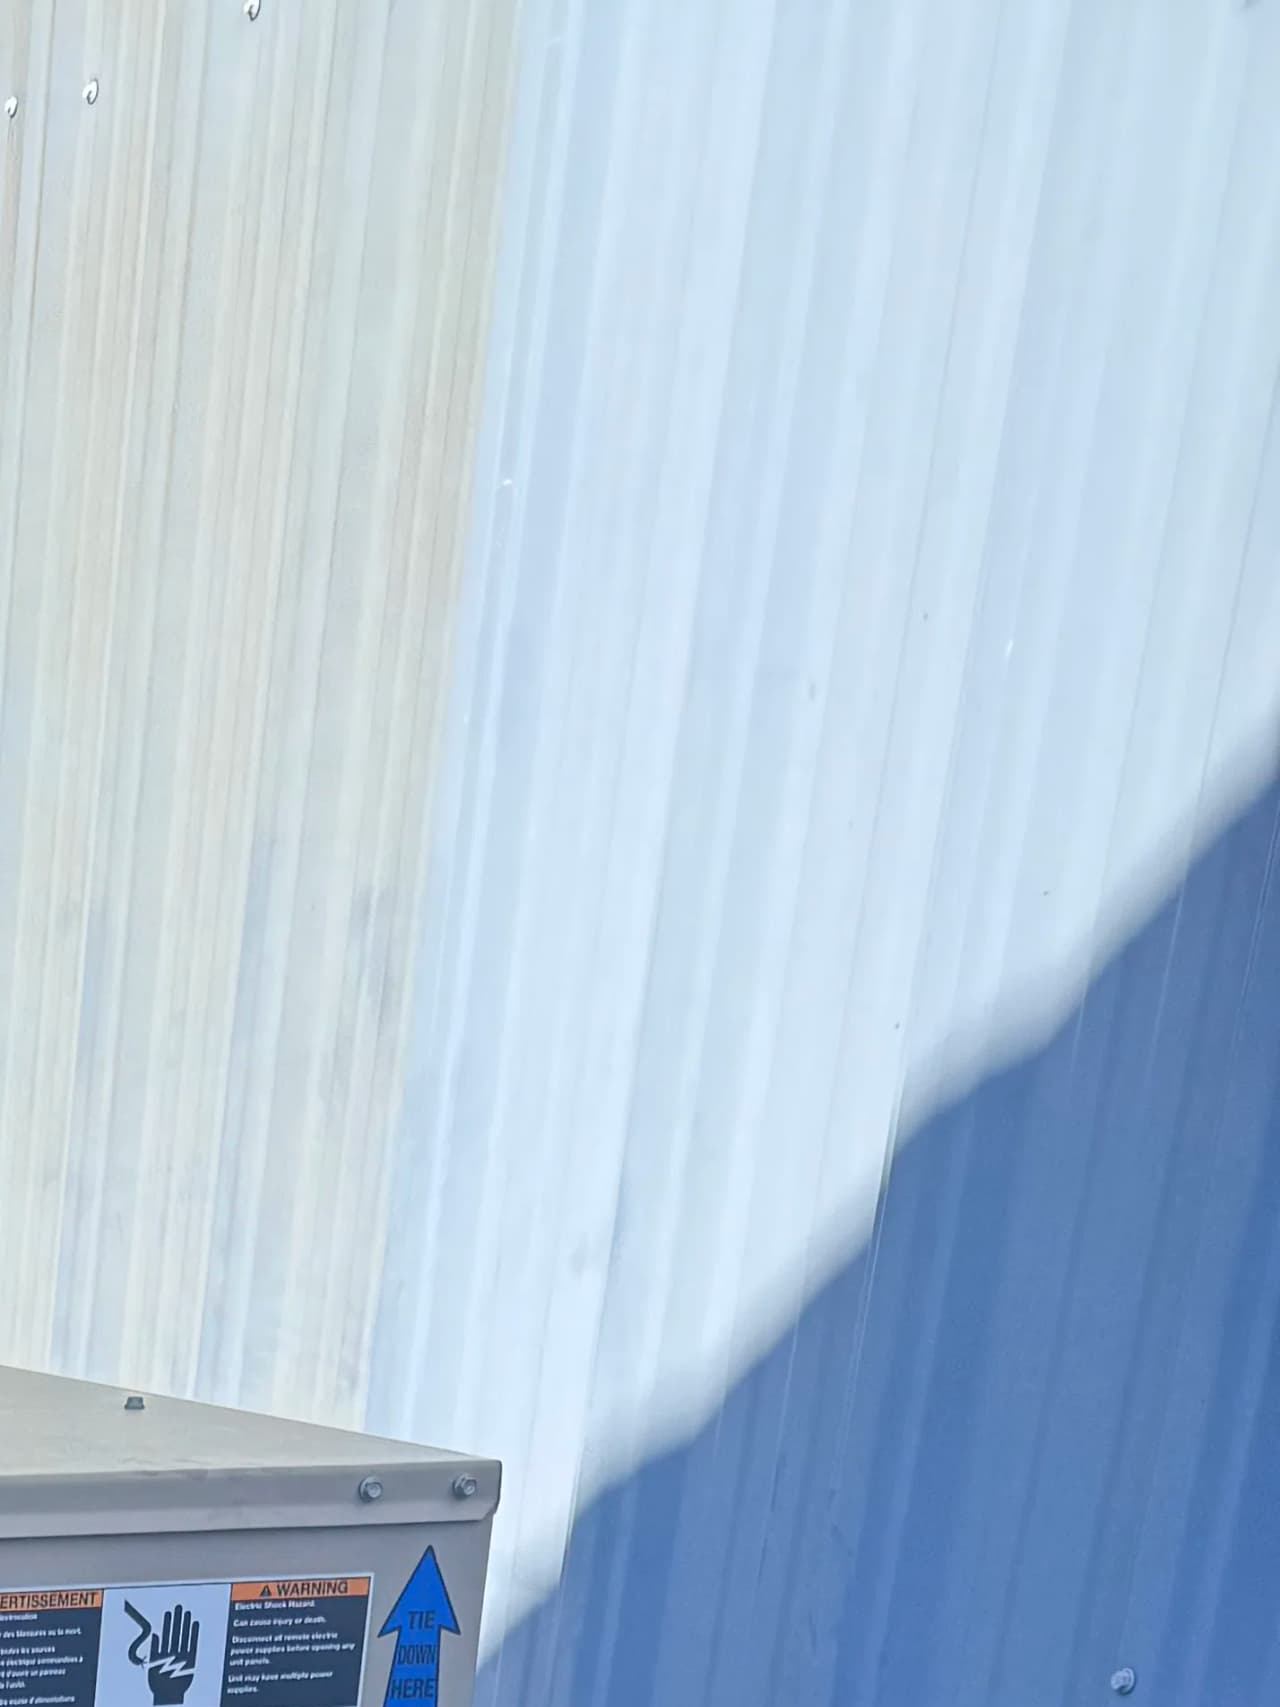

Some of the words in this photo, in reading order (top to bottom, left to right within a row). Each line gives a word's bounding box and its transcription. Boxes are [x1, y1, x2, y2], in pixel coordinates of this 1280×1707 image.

[276, 1580, 348, 1596] WARNING
[409, 1611, 435, 1630] TIE
[397, 1645, 436, 1664] DOWN
[391, 1678, 435, 1698] HERE
